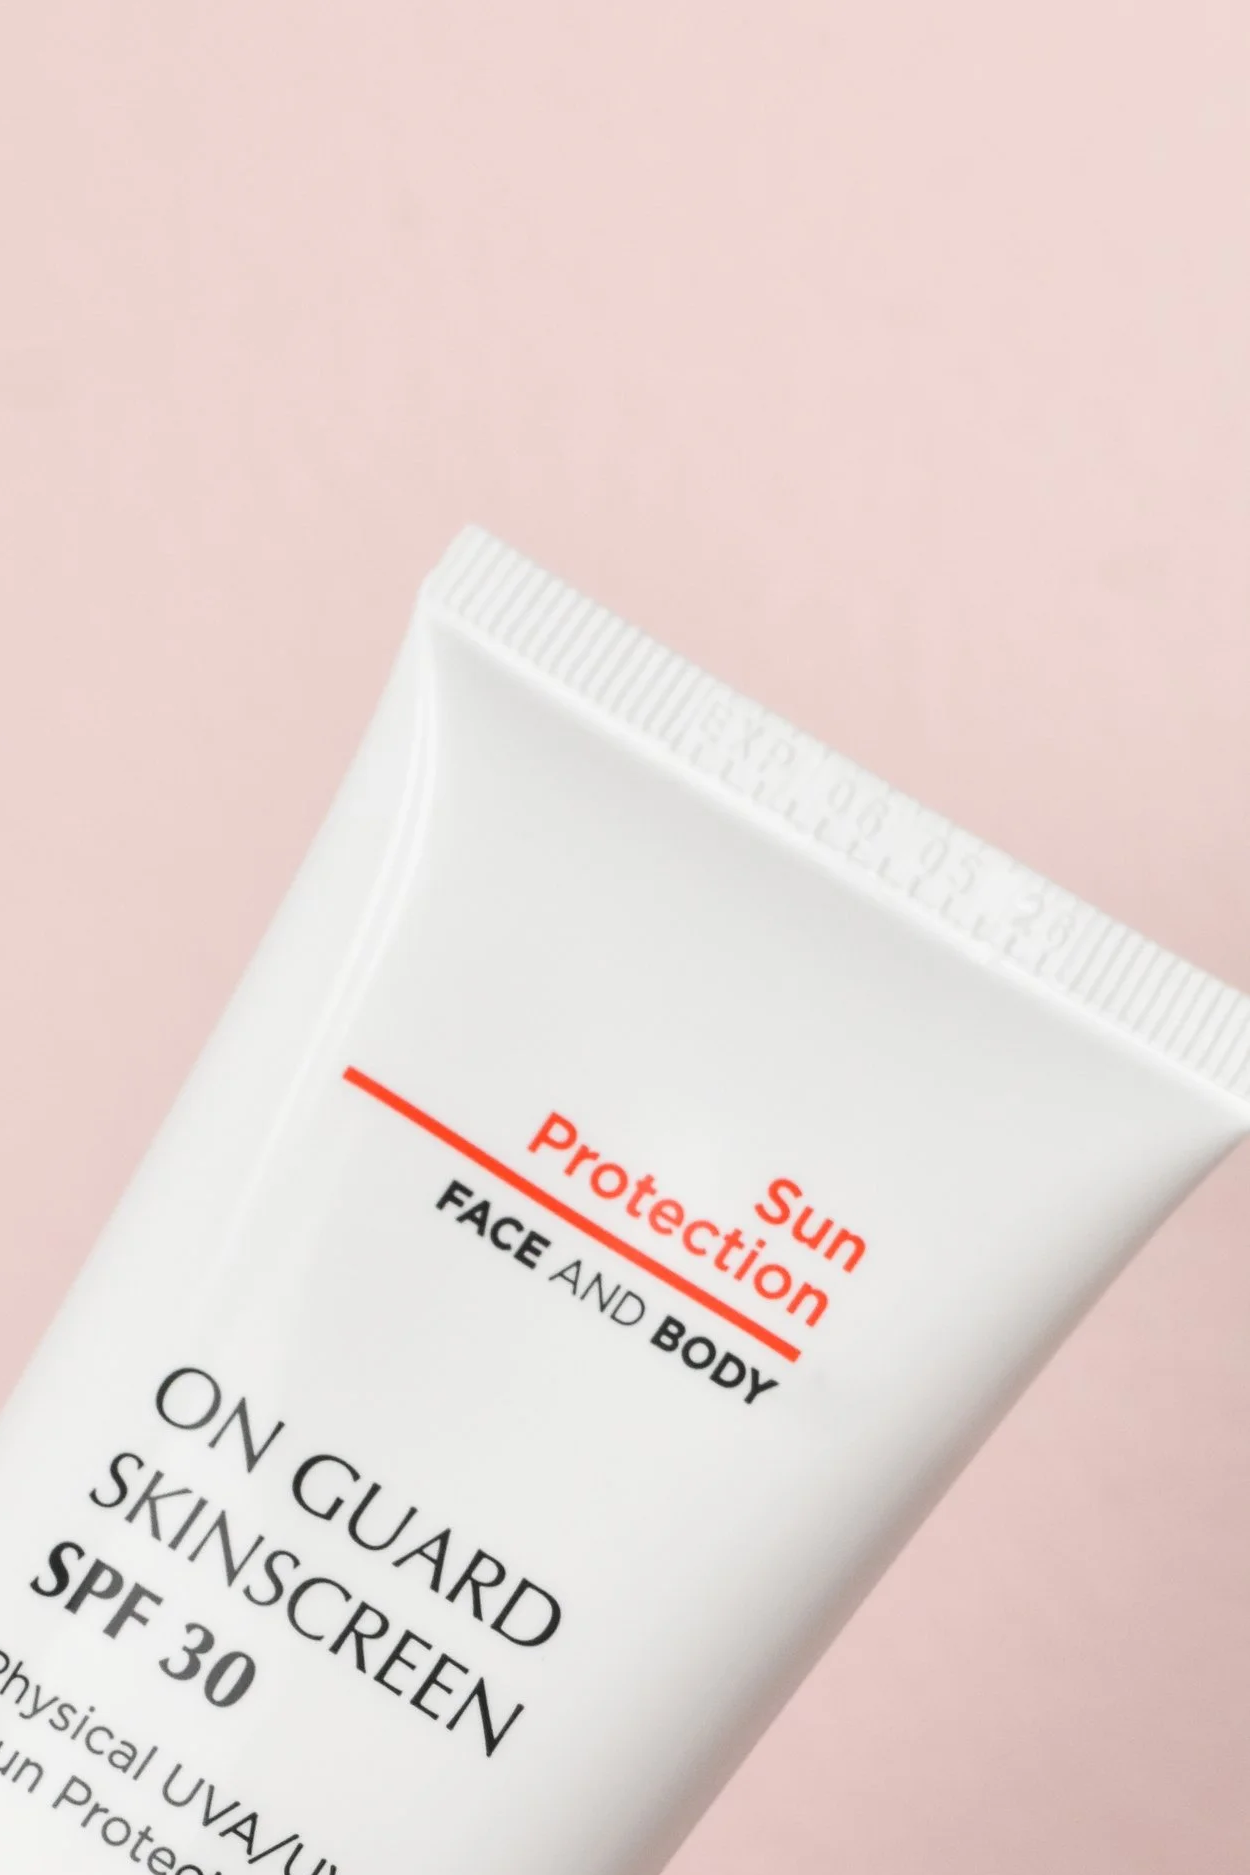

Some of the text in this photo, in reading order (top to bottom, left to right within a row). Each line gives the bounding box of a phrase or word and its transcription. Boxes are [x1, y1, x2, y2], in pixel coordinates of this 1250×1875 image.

[434, 1178, 781, 1406] FACE AND BODY
[525, 1110, 830, 1329] Protection
[753, 1176, 868, 1274] Sun
[88, 1451, 526, 1759] SKINSCREEN
[154, 1366, 562, 1648] ON GUARD
[28, 1540, 257, 1709] SPF 30
